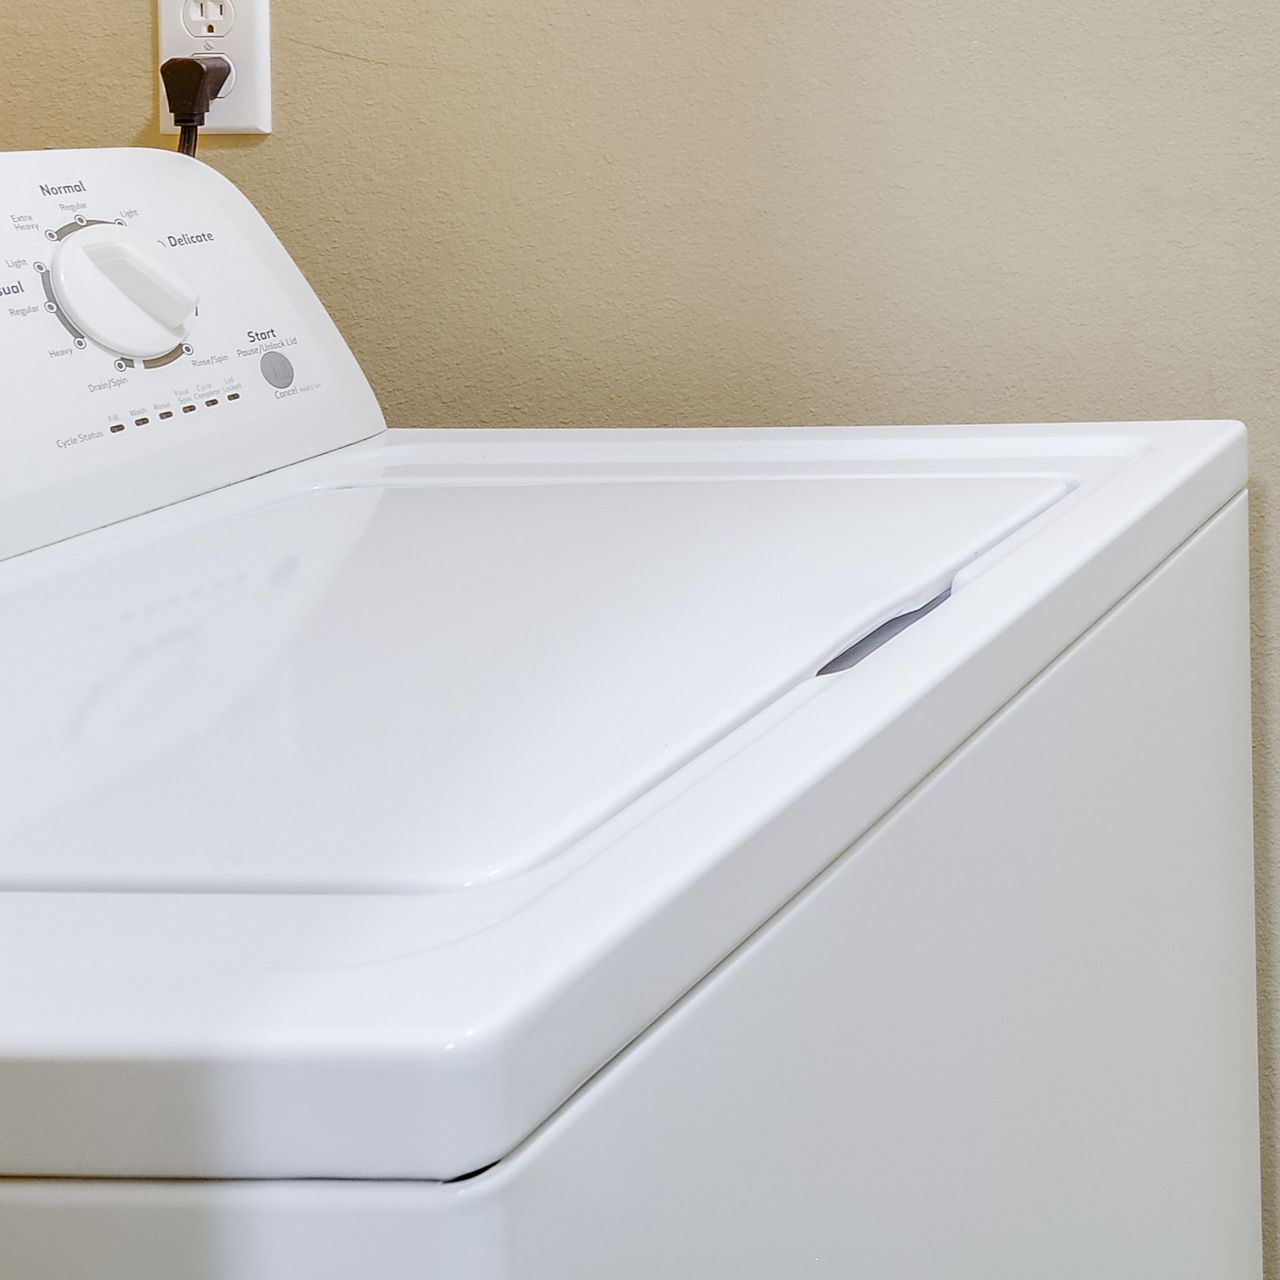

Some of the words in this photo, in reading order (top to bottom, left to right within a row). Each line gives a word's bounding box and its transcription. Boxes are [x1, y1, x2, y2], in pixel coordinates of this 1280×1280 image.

[39, 180, 87, 197] Normal
[167, 231, 214, 247] Delicate
[8, 305, 39, 317] Regular
[247, 328, 277, 343] Start
[88, 377, 128, 393] Drain/Spin
[274, 387, 299, 400] Cancel
[56, 436, 78, 449] Cycle
[78, 430, 104, 444] Status
